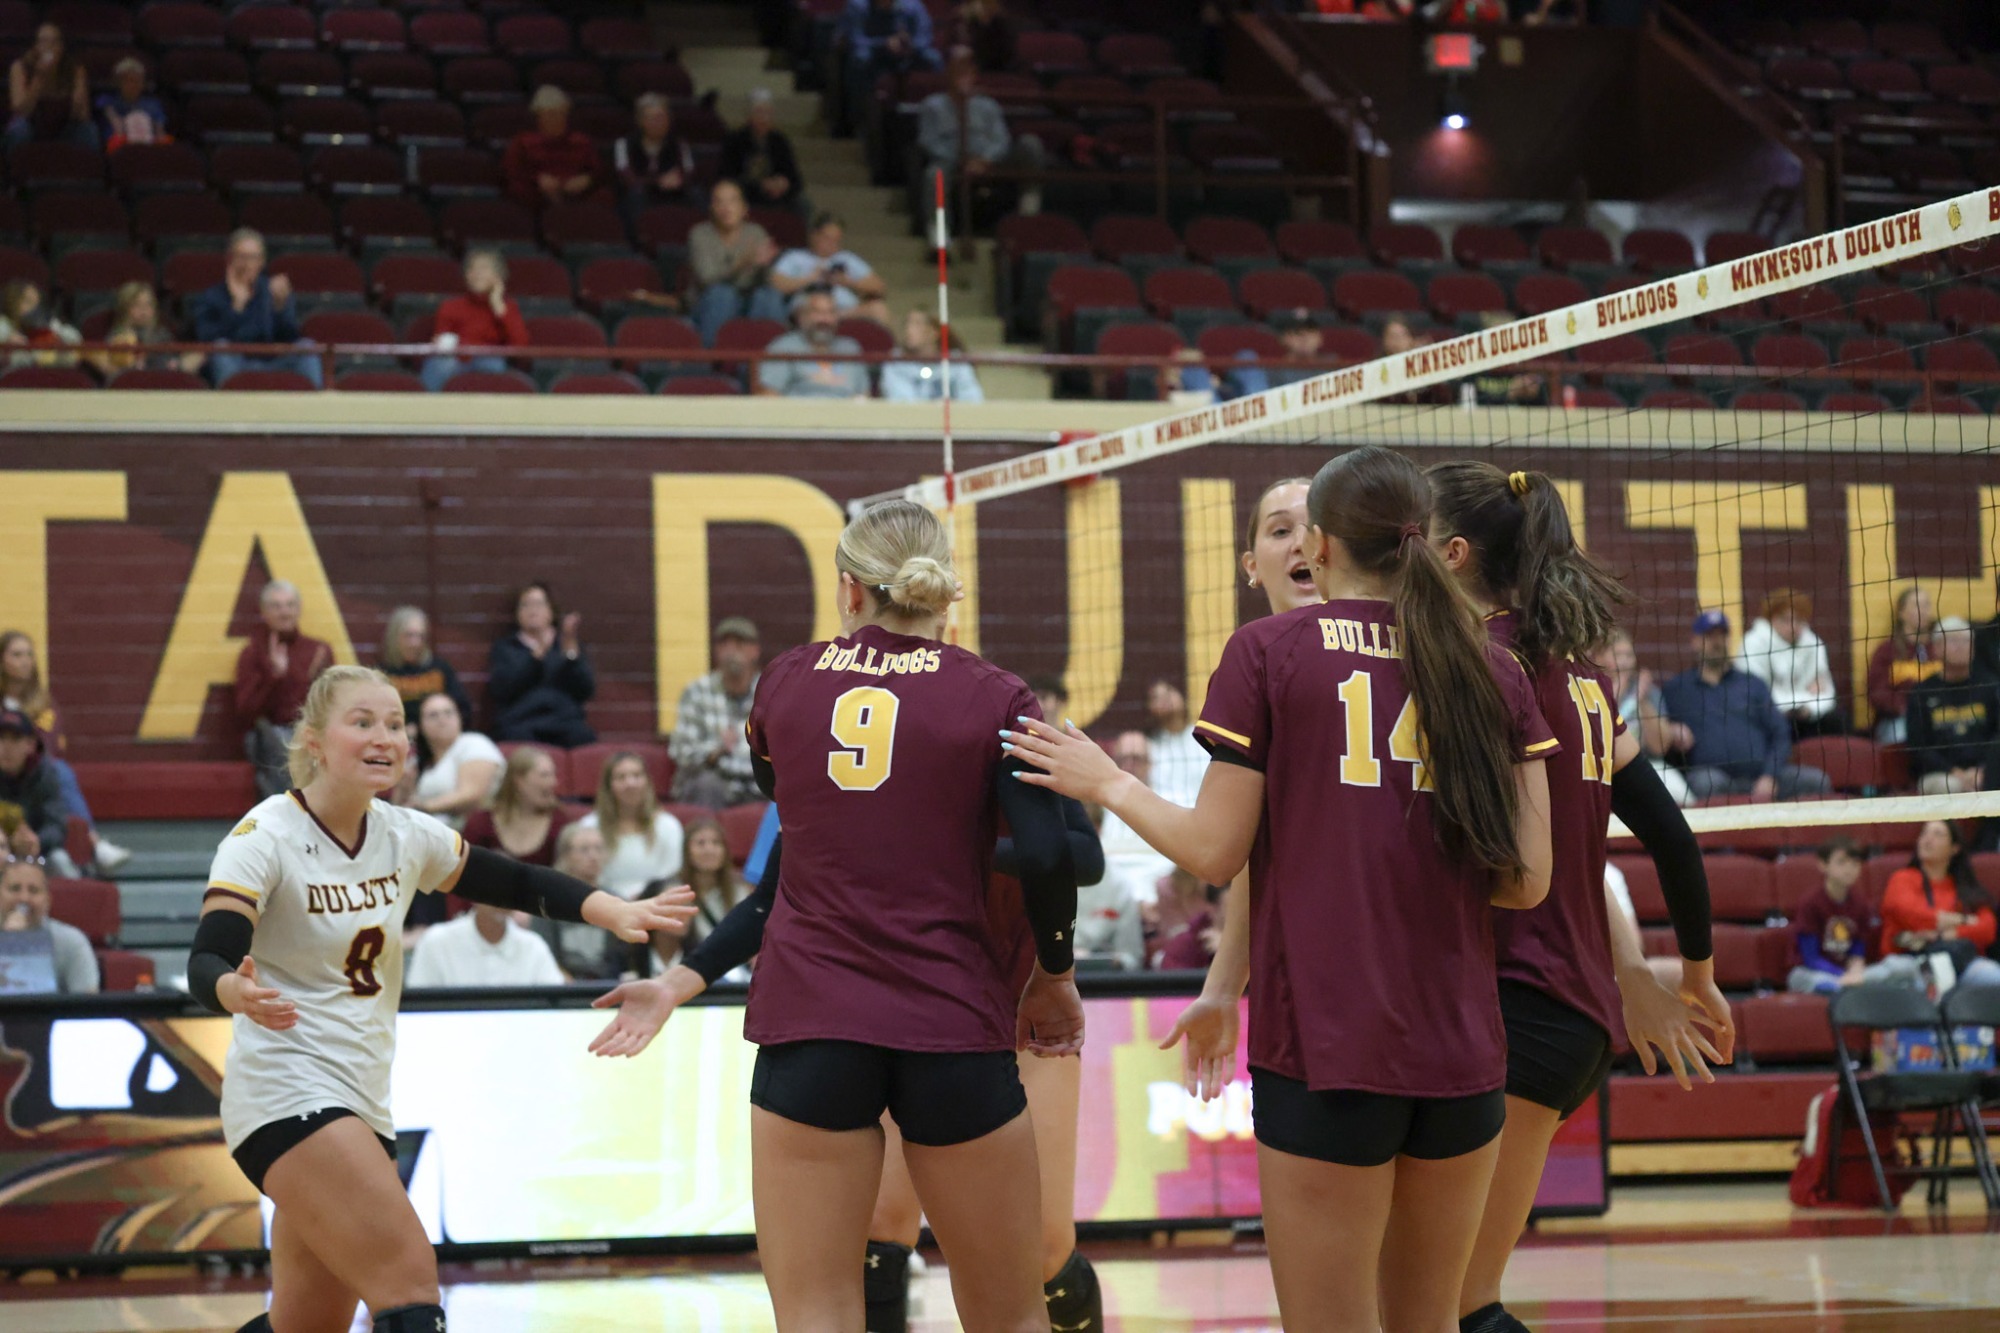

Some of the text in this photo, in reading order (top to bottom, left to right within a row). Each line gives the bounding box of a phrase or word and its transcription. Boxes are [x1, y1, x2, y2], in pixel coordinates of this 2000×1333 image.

[1731, 210, 1922, 292] MINNESOTA DULUTH
[1597, 282, 1678, 328] BULLDOGS
[1405, 317, 1549, 379] MINNESOTA DULUTH
[1302, 368, 1365, 406] BULLDOGS
[652, 472, 2000, 740] DULTH
[1318, 618, 1405, 660] BULLD
[814, 642, 942, 677] BULLDOGS
[827, 685, 900, 791] 9
[1338, 669, 1434, 793] 14
[343, 925, 386, 998] 8
